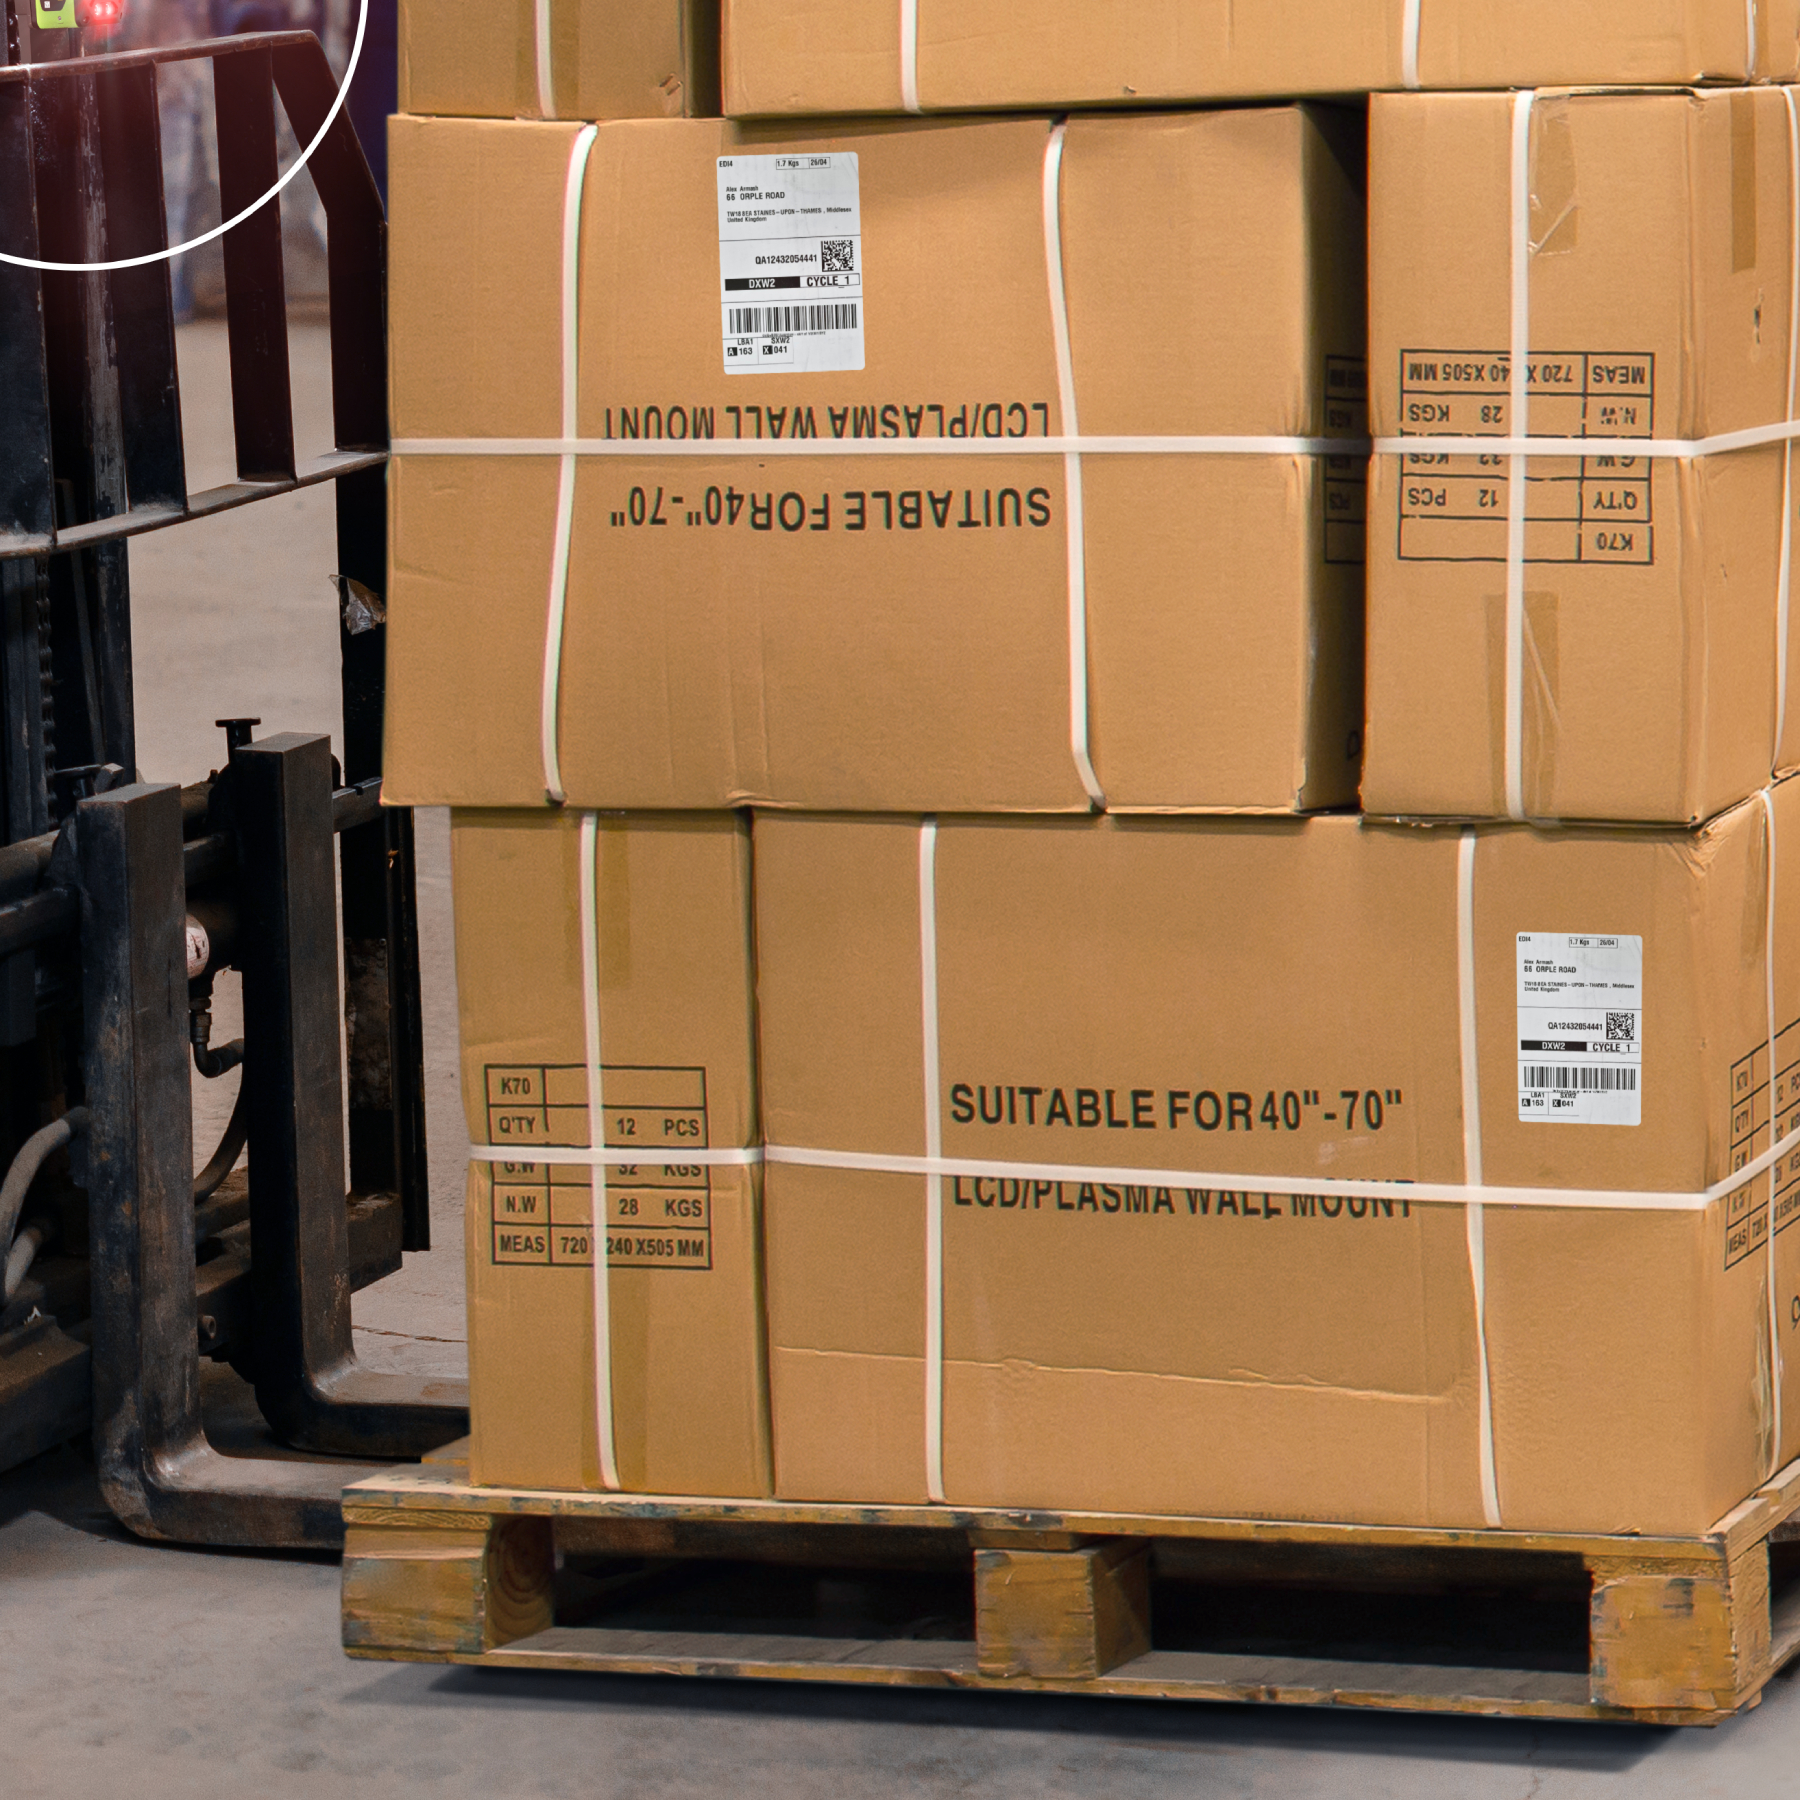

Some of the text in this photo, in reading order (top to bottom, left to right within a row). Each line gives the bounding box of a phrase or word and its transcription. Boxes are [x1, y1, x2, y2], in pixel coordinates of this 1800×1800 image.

[788, 160, 800, 168] Kgs
[740, 193, 763, 201] ORPLE
[755, 255, 818, 265] QA12432054441
[749, 279, 776, 289] DXW2
[774, 346, 788, 354] 041
[1409, 363, 1437, 381] MM
[1543, 365, 1573, 383] 720
[1593, 365, 1645, 385] MEAS
[602, 402, 1049, 439] LCD/PLASMA WALL MOUNT
[1409, 405, 1450, 422] KGS
[1481, 406, 1503, 423] 28
[1408, 488, 1638, 510] Q'TY 12 PCS
[751, 492, 831, 532] FOR
[844, 487, 1051, 531] SUITABLE
[1597, 533, 1633, 551] K70
[1559, 966, 1577, 974] ROAD
[1542, 1042, 1566, 1050] DXW2
[501, 1078, 531, 1095] K70
[952, 1083, 1157, 1129] SUITABLE
[1168, 1090, 1253, 1131] FOR
[499, 1117, 700, 1136] Q'TY 12 PCS
[506, 1196, 703, 1217] N.W 28 KGS
[954, 1175, 1176, 1215] LCD/PLASMA
[1186, 1188, 1282, 1220] WALL
[500, 1236, 546, 1253] MEAS
[561, 1237, 588, 1254] 720
[606, 1238, 633, 1255] 240
[678, 1239, 704, 1257] MM
